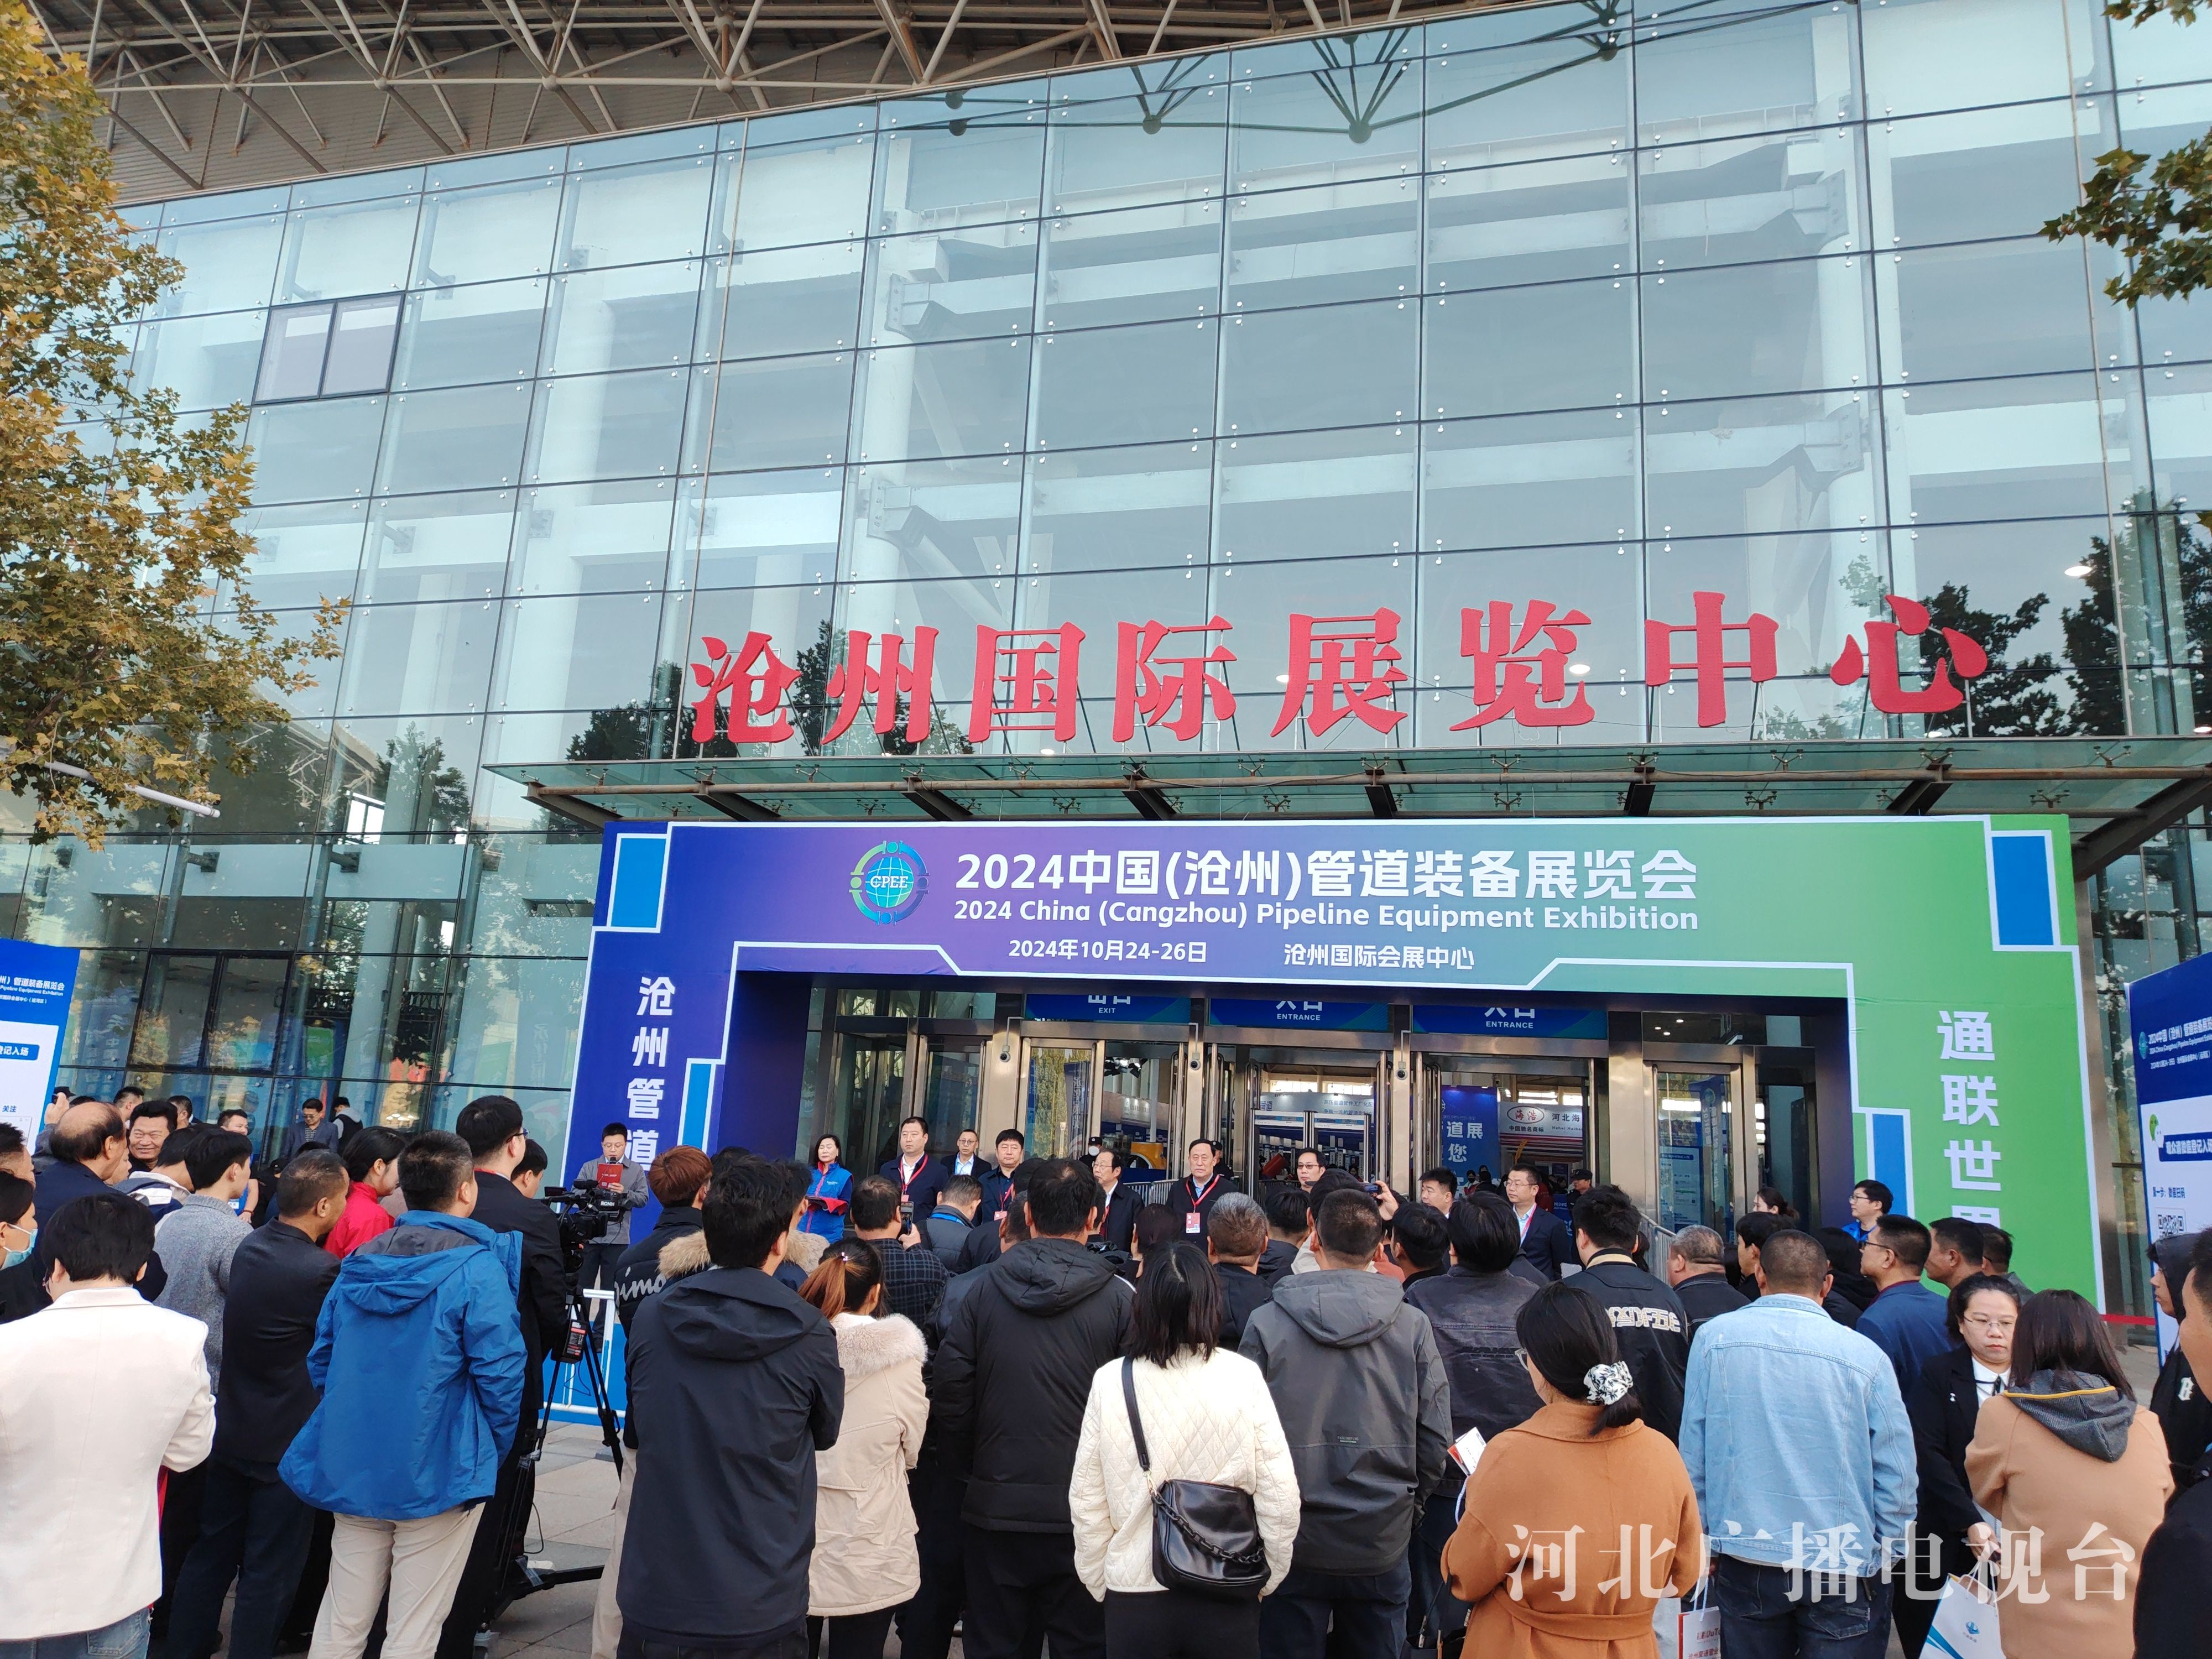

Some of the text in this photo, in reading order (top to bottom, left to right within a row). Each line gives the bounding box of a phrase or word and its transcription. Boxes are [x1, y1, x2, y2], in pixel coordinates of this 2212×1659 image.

[690, 591, 1988, 744] 沧州国际展览中心
[870, 875, 909, 888] CPEE
[955, 849, 1697, 900] 2024中国(沧州)管道装备展览会
[954, 900, 1699, 932] 2024 China (Cangzhou) Pipeline Equipment Exhibition
[1008, 939, 1475, 970] 2024年10月24-26日 沧州国际会展中心
[1515, 1109, 1580, 1123] 海浩 河北海
